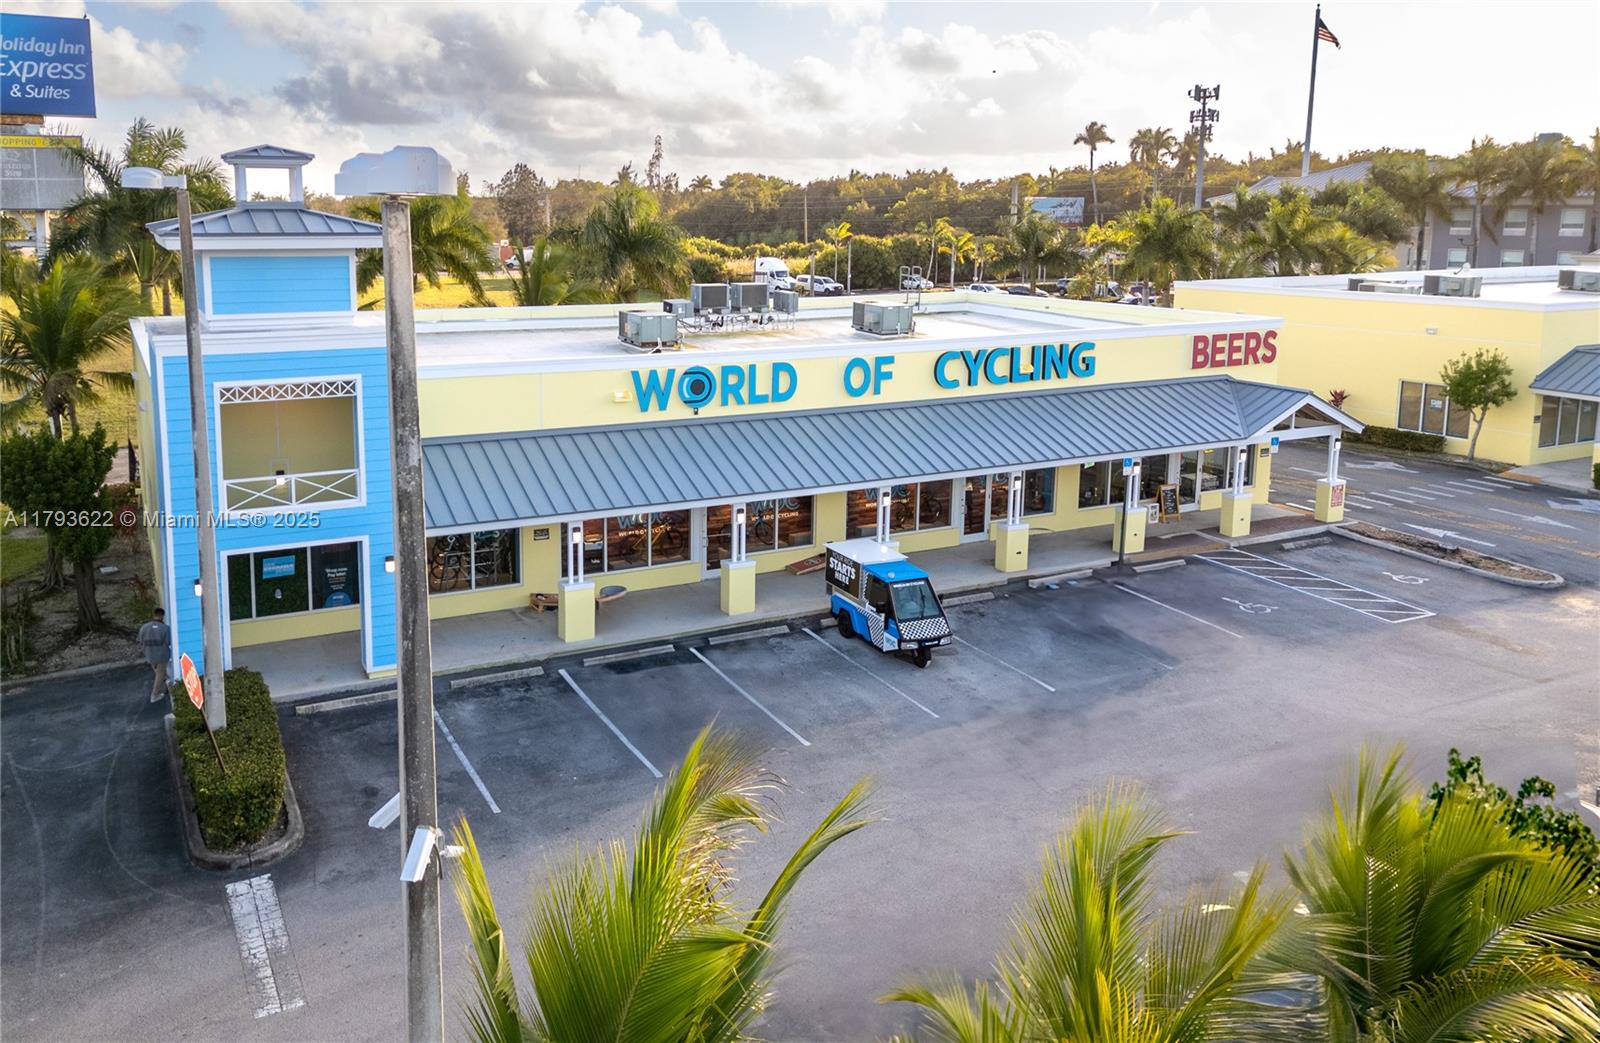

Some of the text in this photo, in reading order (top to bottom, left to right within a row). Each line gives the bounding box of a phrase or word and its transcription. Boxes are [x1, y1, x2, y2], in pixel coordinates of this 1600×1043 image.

[0, 35, 85, 57] oliday Inn
[10, 83, 71, 100] & Suites
[630, 329, 1277, 413] WORLD OF CYCLING BEERS
[829, 557, 856, 580] STARTS
